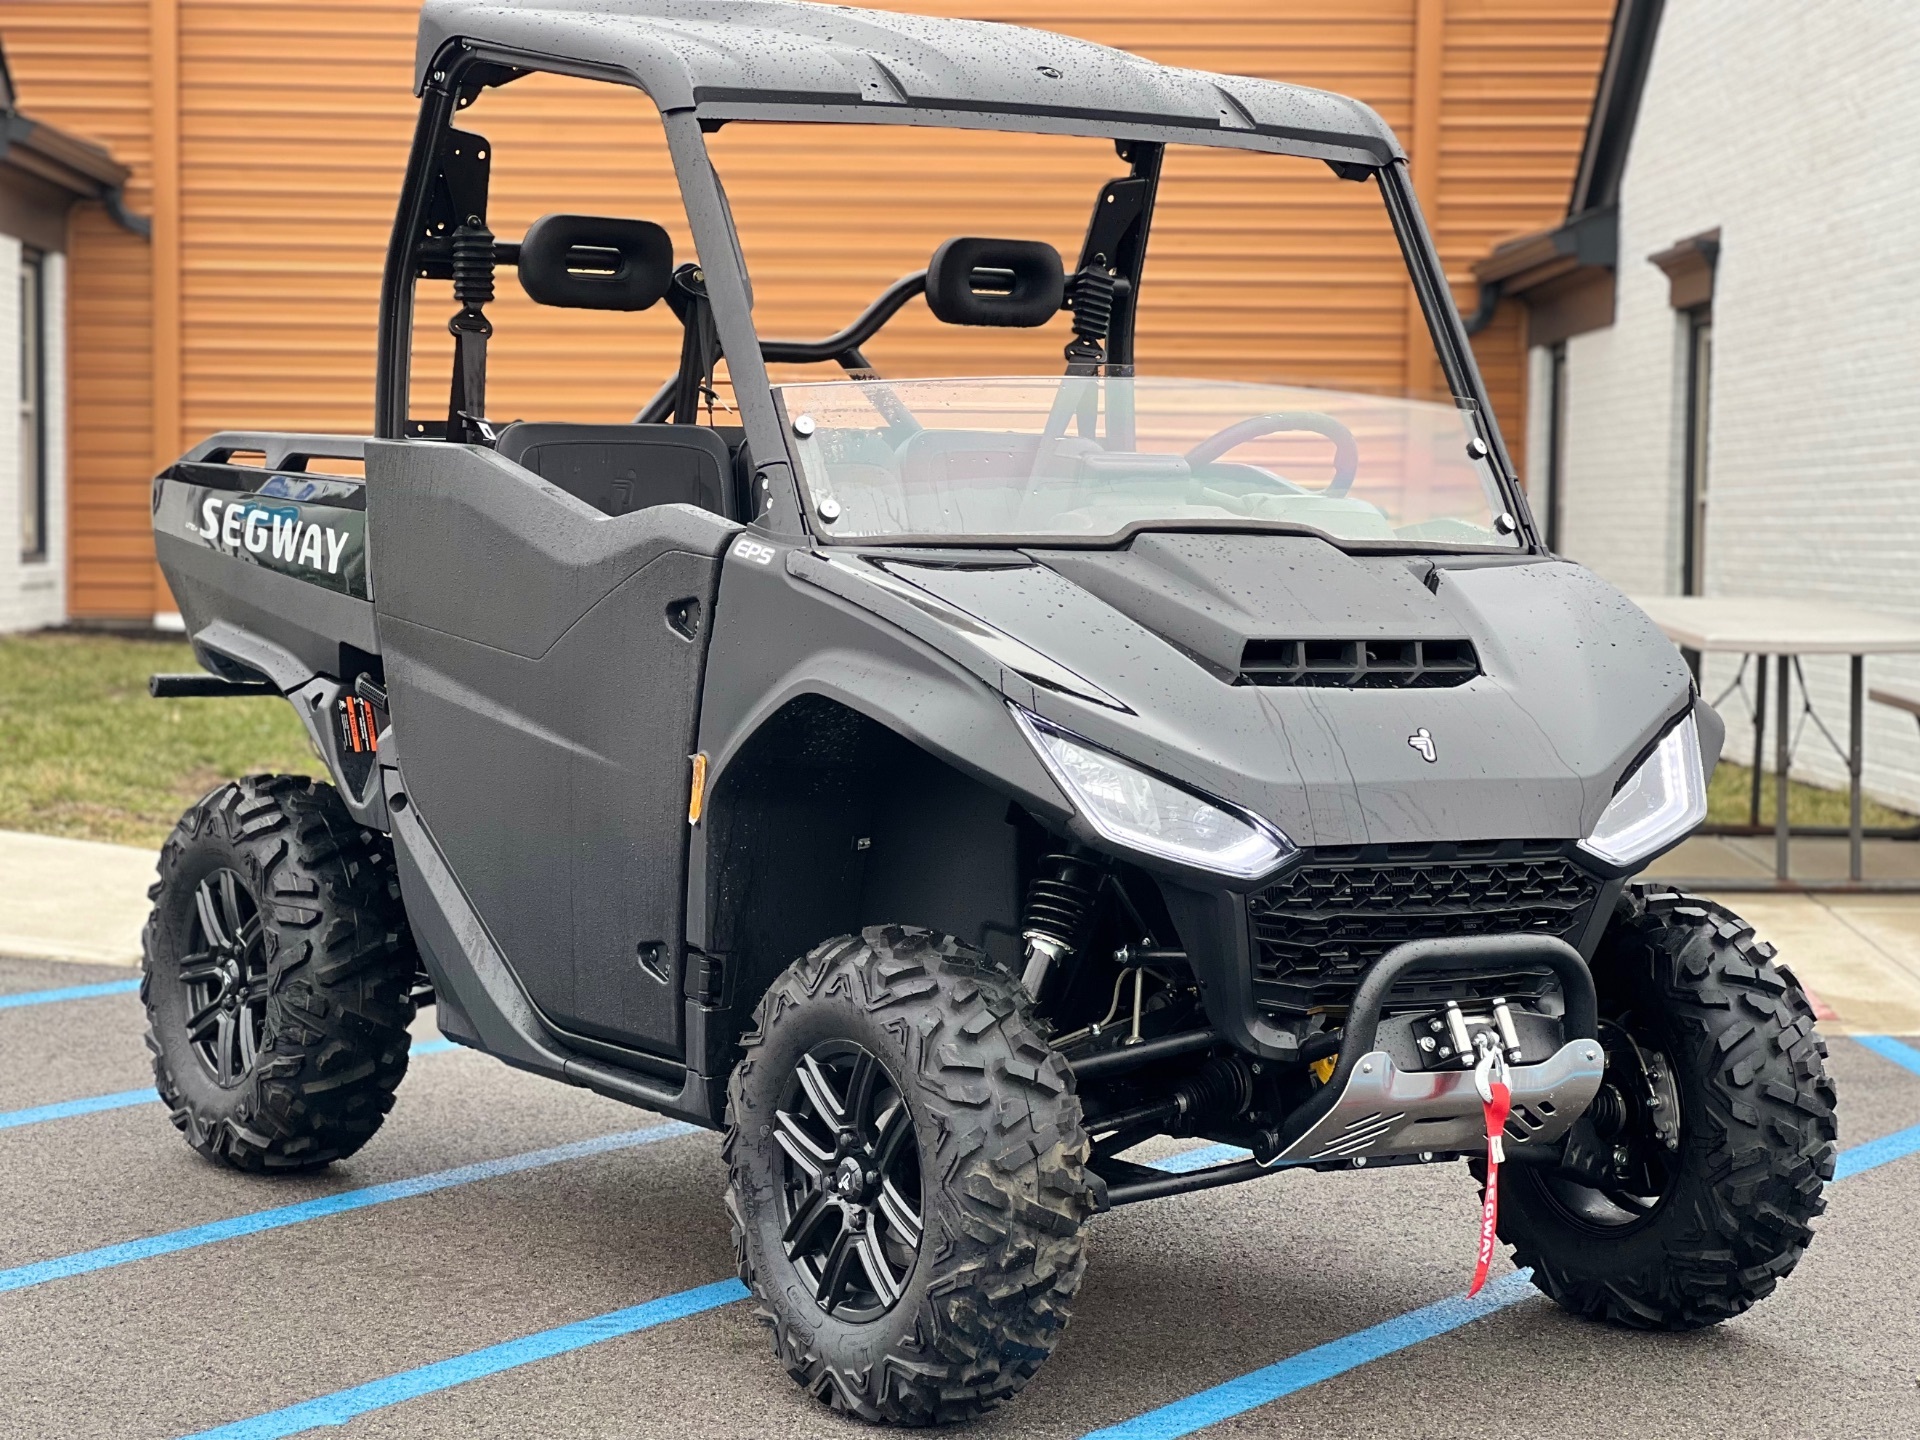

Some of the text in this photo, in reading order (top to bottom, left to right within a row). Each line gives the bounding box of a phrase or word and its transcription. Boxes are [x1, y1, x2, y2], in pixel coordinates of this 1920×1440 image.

[199, 498, 349, 574] SEGWAY
[733, 539, 776, 566] EPS
[1480, 1171, 1496, 1264] SEGWAY
